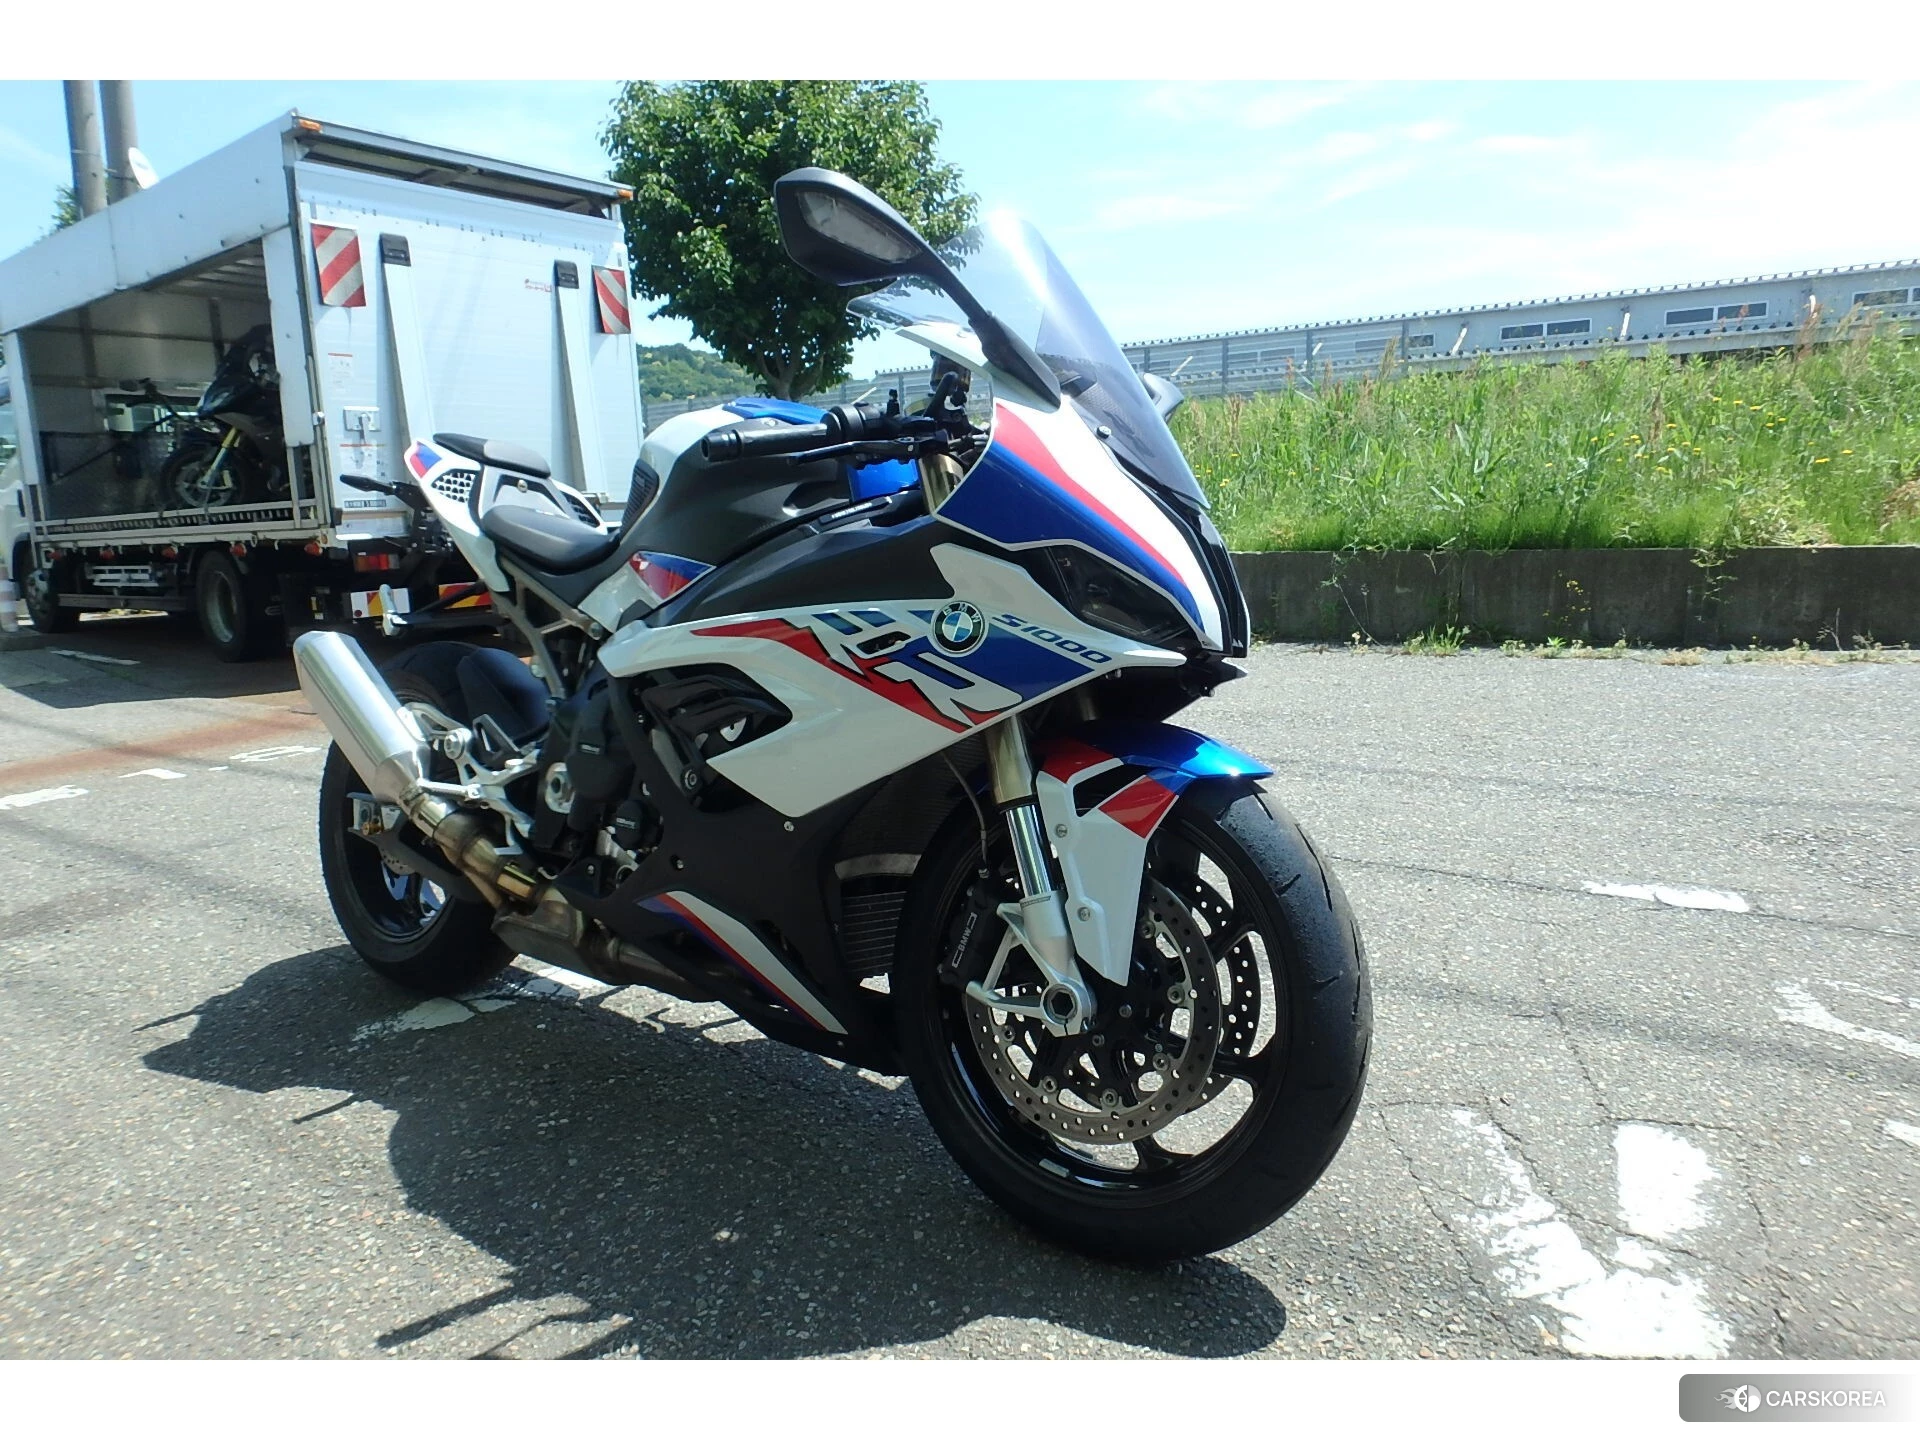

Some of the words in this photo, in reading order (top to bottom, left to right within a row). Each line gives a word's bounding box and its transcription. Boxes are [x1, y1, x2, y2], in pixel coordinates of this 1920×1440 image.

[942, 602, 981, 623] BMW
[991, 613, 1113, 664] S1000
[957, 926, 973, 952] BMW
